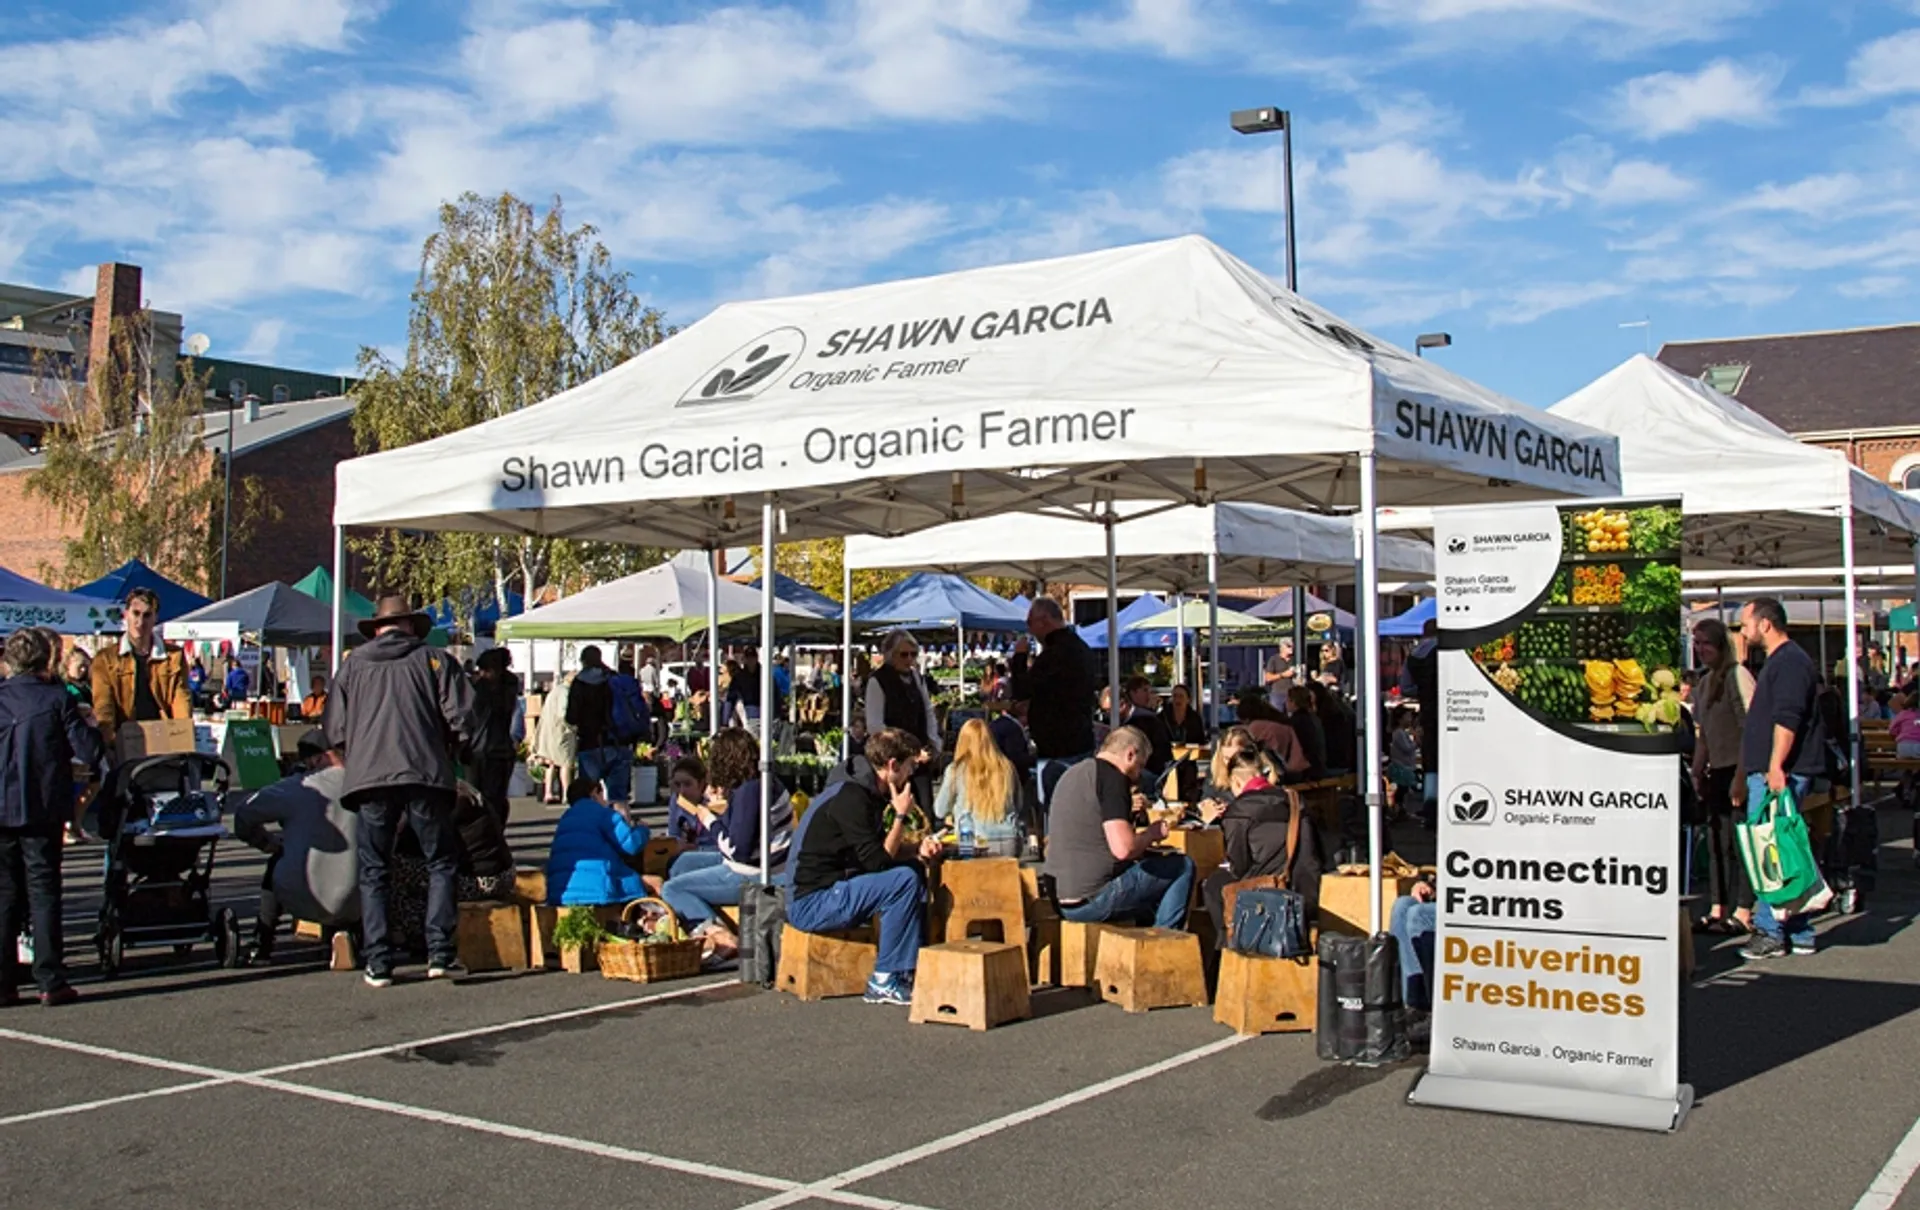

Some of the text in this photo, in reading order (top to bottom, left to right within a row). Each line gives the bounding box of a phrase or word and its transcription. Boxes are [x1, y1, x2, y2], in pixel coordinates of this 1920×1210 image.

[817, 297, 1113, 358] SHAWN GARCIA
[789, 356, 970, 392] Organic Farmer
[501, 455, 624, 491] Shawn
[639, 436, 763, 479] Garcia
[804, 417, 963, 469] Organic
[979, 407, 1135, 450] Farmer
[1396, 399, 1606, 482] SHAWN GARCIA
[1473, 532, 1551, 544] SHAWN GARCIA
[1444, 575, 1509, 585] Shawn Garcia
[1444, 584, 1516, 597] Organic Farmer
[1446, 688, 1489, 698] Connecting
[1446, 697, 1471, 705] Farms
[1446, 706, 1484, 715] Delivering
[1446, 714, 1486, 722] Freshness
[1504, 789, 1669, 810] SHAWN GARCIA
[1504, 812, 1597, 826] Organic Farmer
[1446, 850, 1668, 895] Connecting
[1446, 887, 1564, 920] Farms
[1444, 937, 1641, 985] Delivering
[1442, 974, 1645, 1017] Freshness
[1452, 1037, 1496, 1053] Shawn
[1499, 1041, 1542, 1057] Garcia
[1552, 1045, 1604, 1064] Organic
[1607, 1051, 1654, 1068] Farmer
